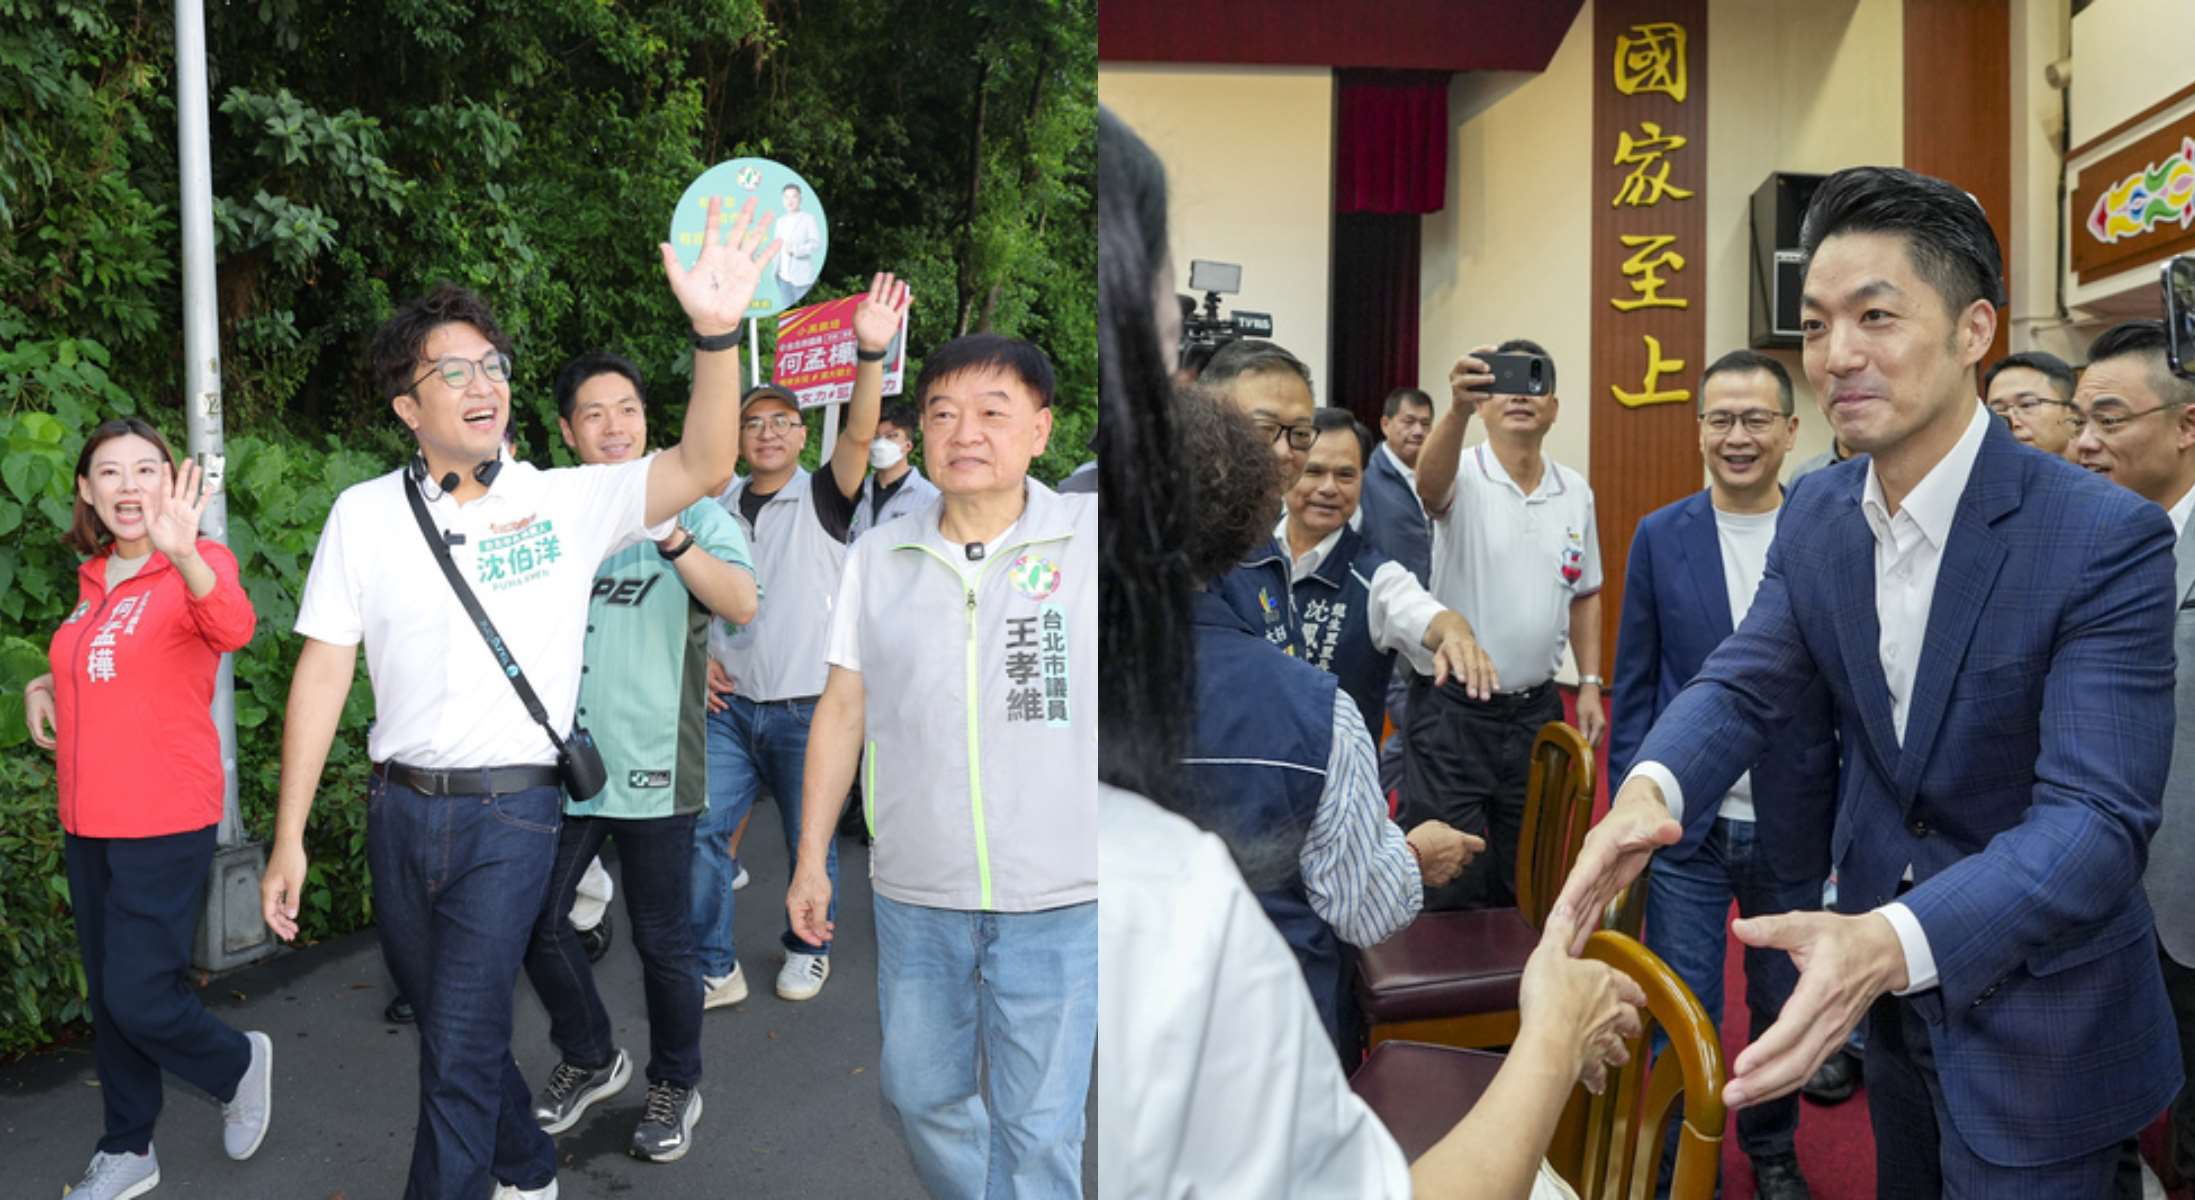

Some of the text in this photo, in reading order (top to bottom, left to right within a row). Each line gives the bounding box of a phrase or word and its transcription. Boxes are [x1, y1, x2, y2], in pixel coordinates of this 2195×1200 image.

[1610, 22, 1695, 408] 國家至上
[1237, 316, 1271, 330] TVBS
[476, 534, 562, 583] 沈伯洋
[592, 573, 662, 607] PEI
[1005, 615, 1044, 723] 王孝維
[1043, 608, 1068, 723] 台北市議員
